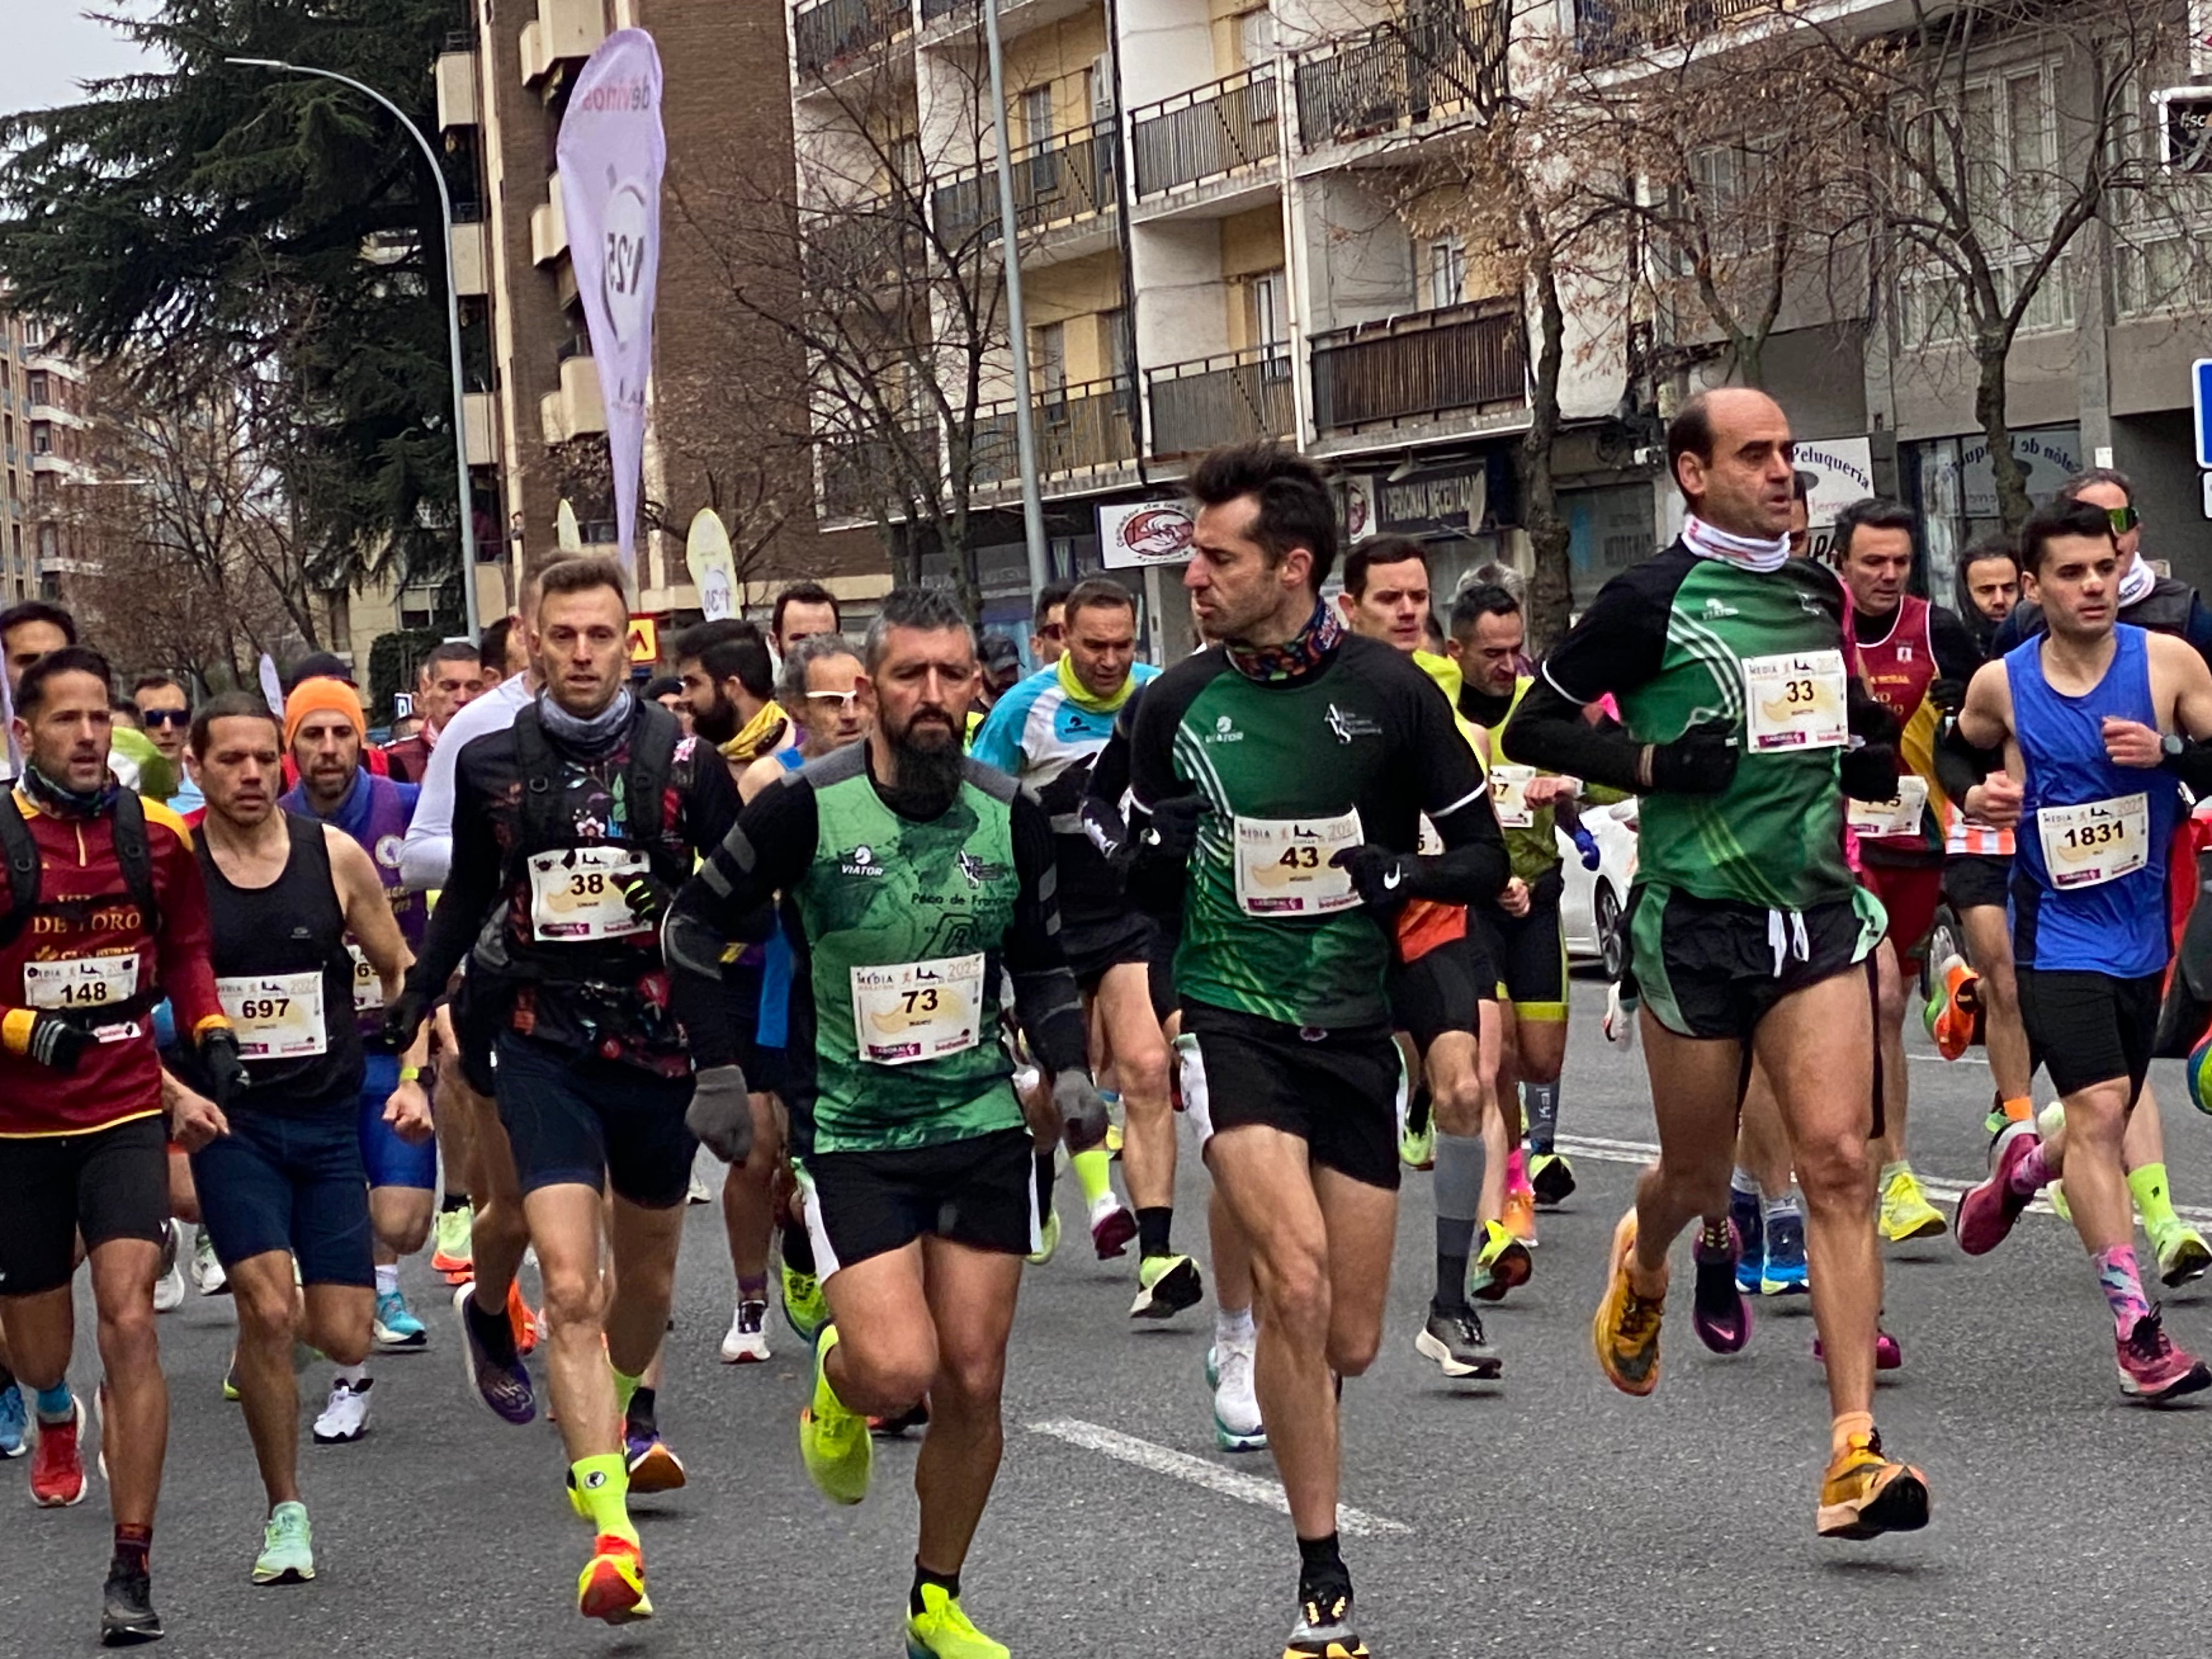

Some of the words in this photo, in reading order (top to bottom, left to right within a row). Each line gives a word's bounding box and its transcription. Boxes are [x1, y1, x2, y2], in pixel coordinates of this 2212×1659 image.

[1786, 680, 1814, 702] 33
[2065, 820, 2124, 848] 1831
[1279, 847, 1319, 868] 43
[842, 865, 883, 877] VIATOR
[571, 873, 604, 895] 38
[950, 893, 966, 904] de
[32, 917, 67, 933] DE
[78, 912, 142, 932] ORO
[858, 974, 893, 984] MEDIA
[948, 962, 980, 977] 2025
[60, 982, 107, 1003] 148
[901, 989, 938, 1014] 73
[242, 998, 290, 1019] 697
